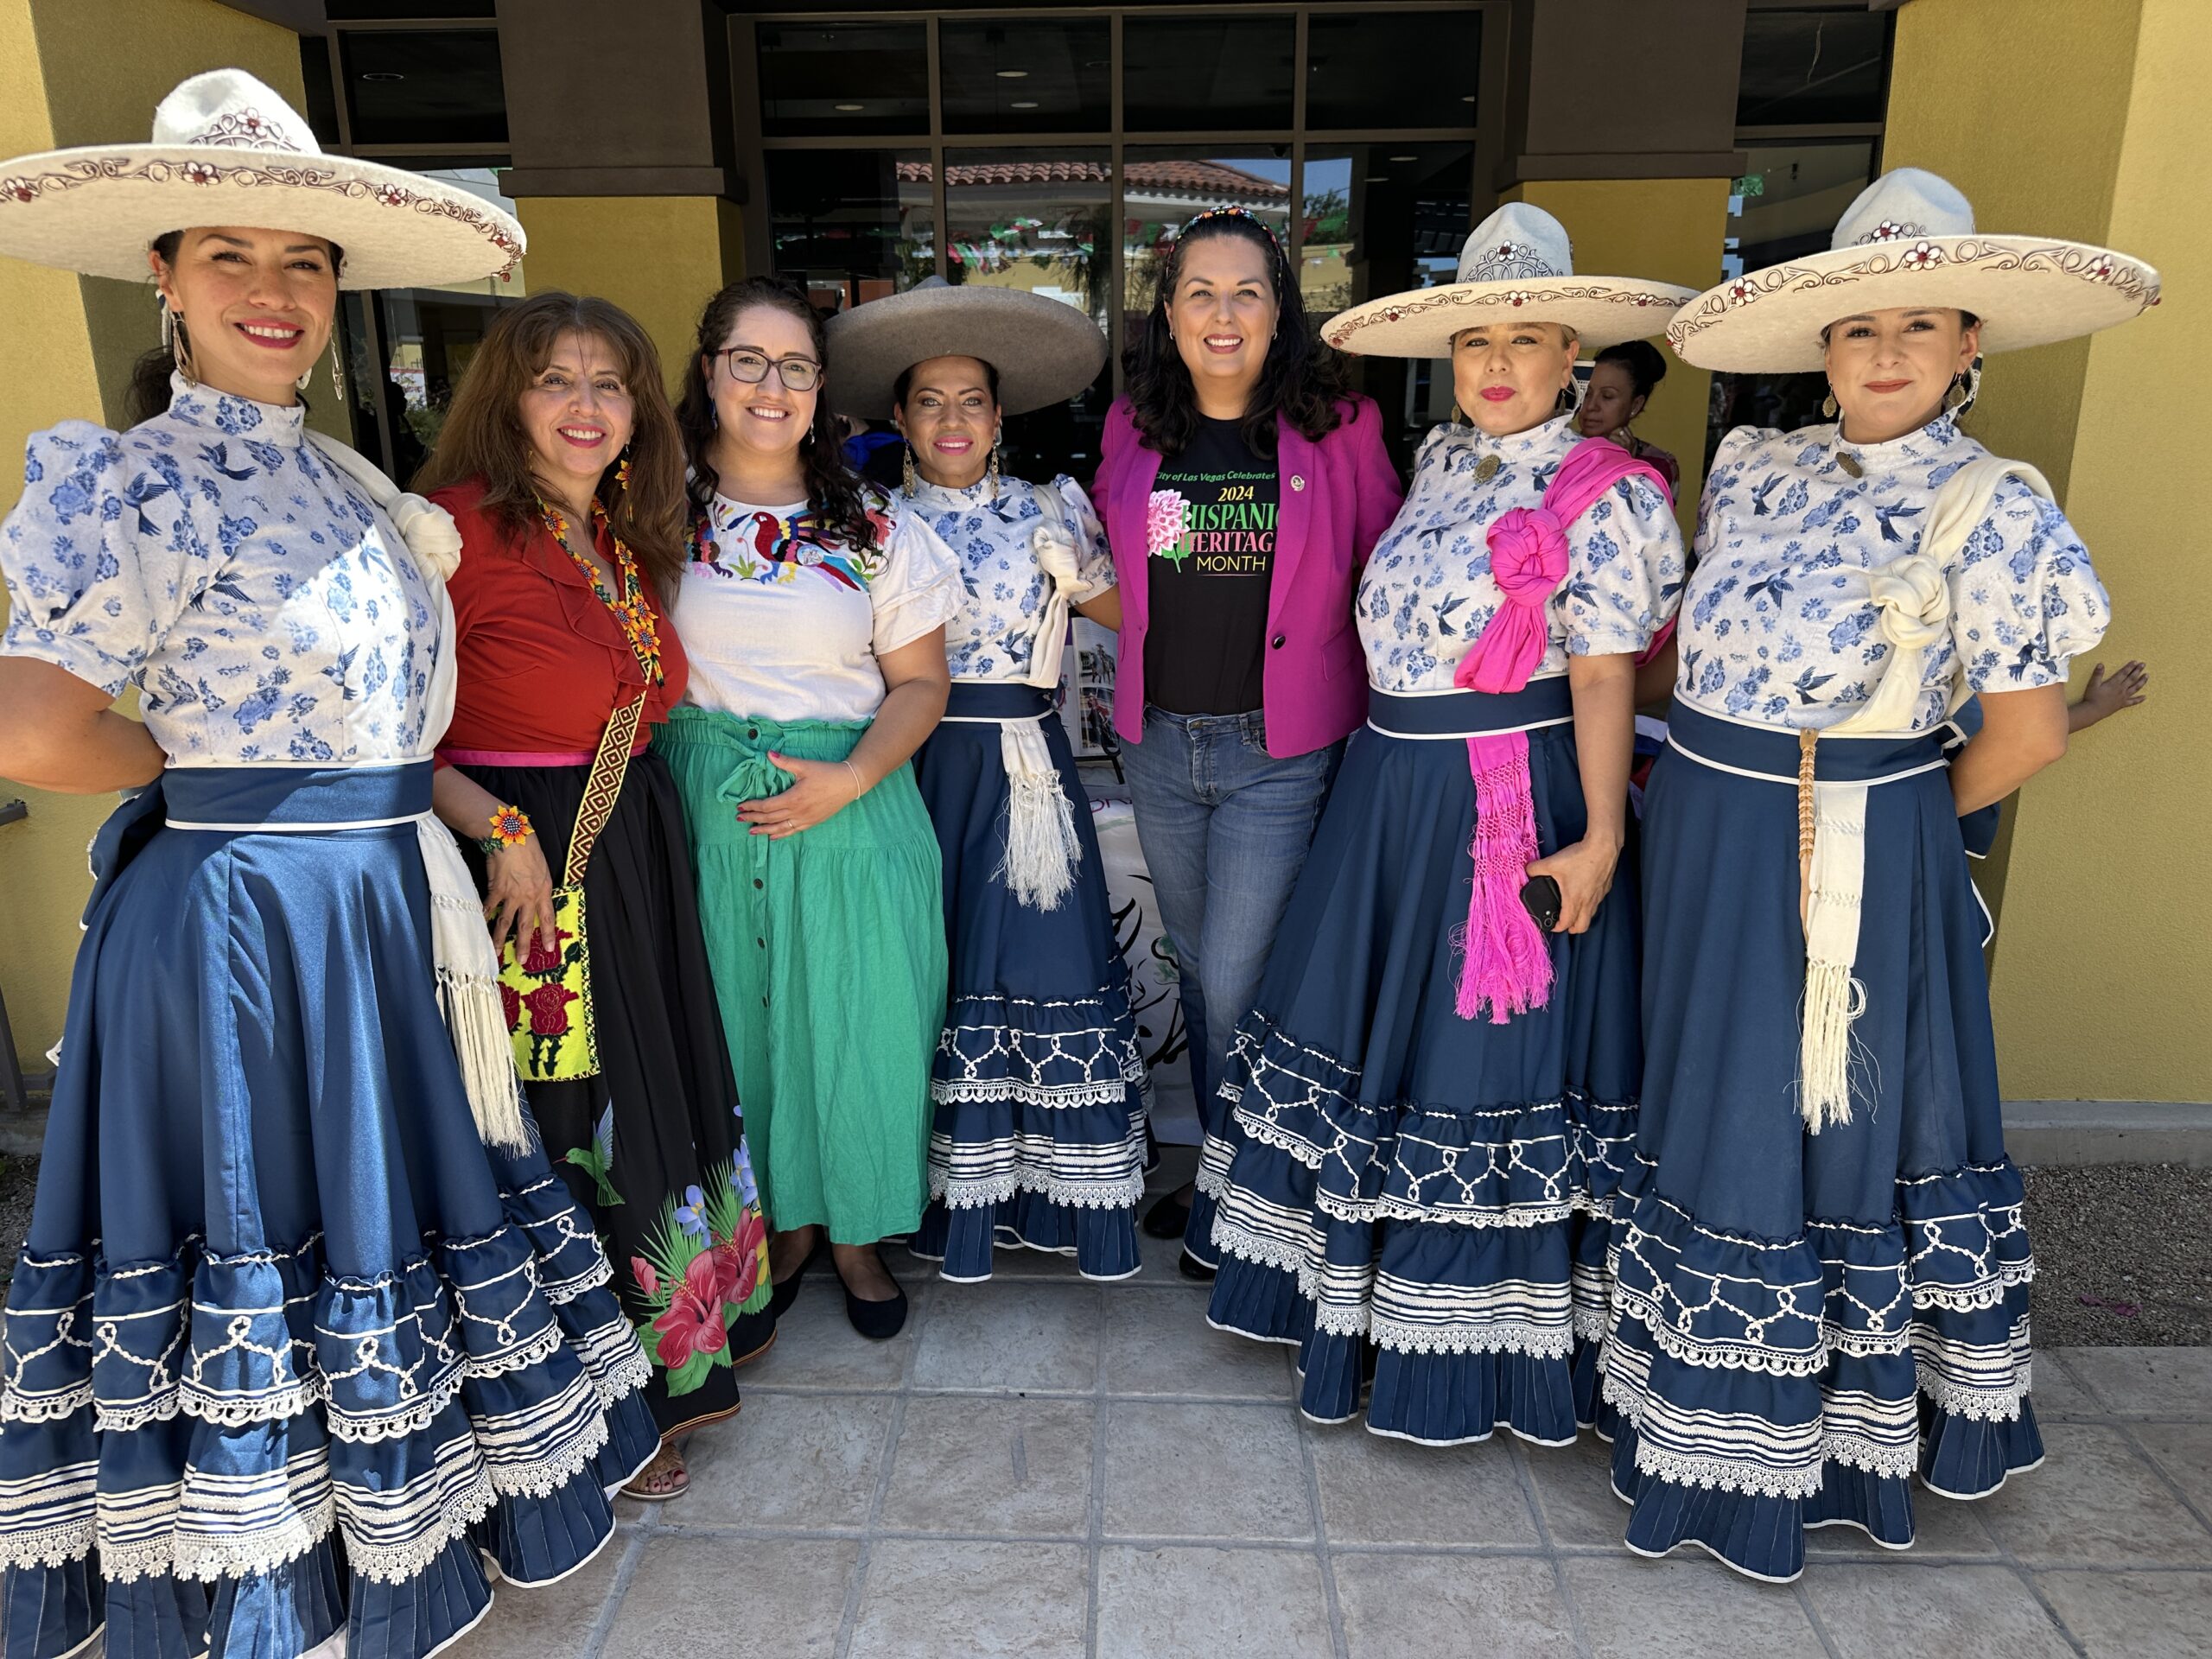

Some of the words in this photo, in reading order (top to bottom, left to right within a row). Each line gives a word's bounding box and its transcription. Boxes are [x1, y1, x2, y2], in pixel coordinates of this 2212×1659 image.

[1172, 473, 1183, 481] of
[1183, 473, 1198, 481] Las
[1200, 473, 1225, 482] Vegas
[1227, 470, 1275, 480] Celebrates
[1217, 486, 1254, 501] 2024
[1181, 503, 1279, 531] HISPANI
[1180, 531, 1276, 553] HERITAG
[1197, 556, 1266, 571] MONTH
